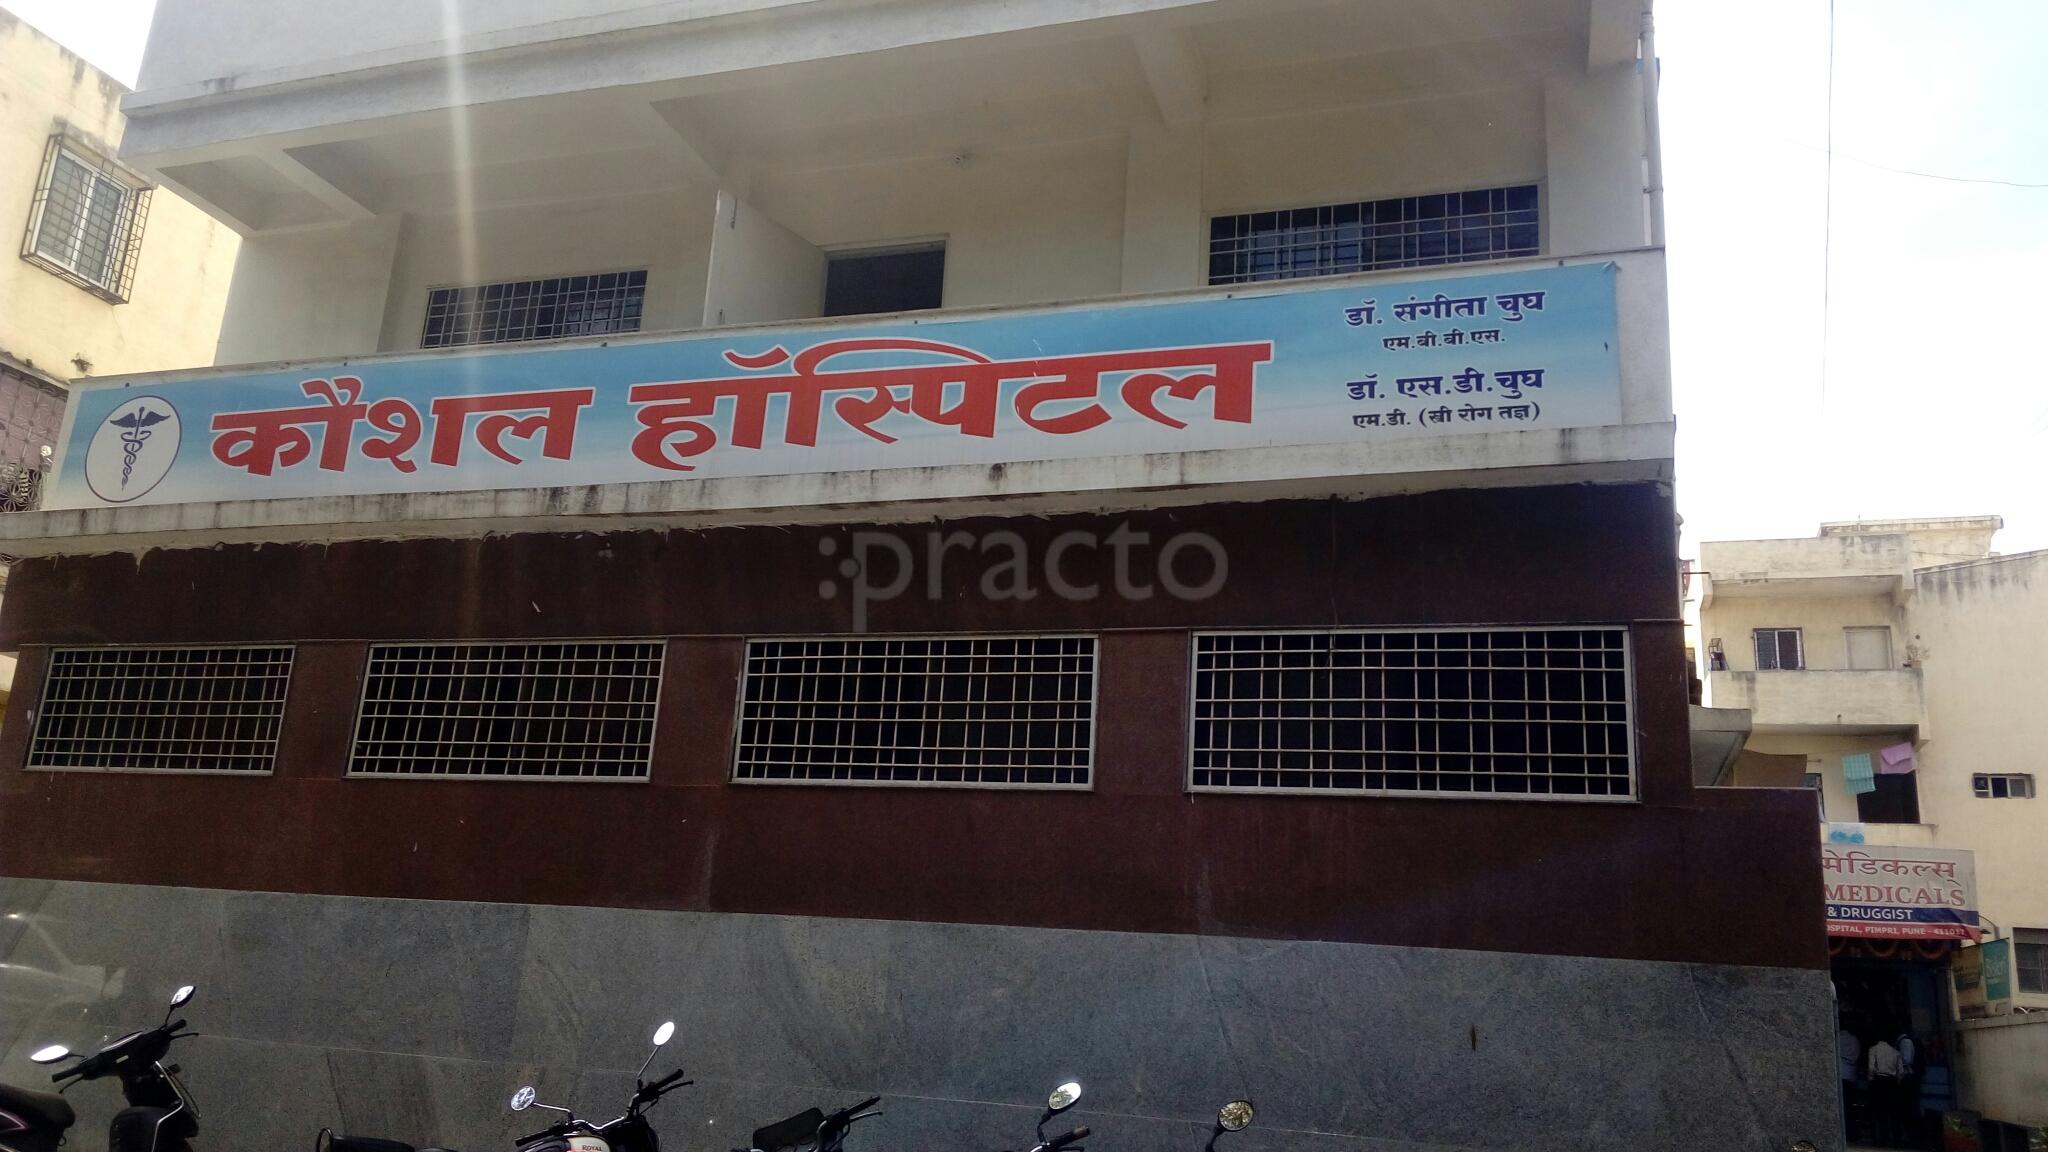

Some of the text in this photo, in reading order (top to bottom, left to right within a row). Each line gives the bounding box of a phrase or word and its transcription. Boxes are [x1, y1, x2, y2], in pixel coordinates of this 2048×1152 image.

[1345, 291, 1546, 326] डॉ. संगीता चुघ
[1347, 373, 1385, 400] डॉ.
[212, 338, 1272, 476] कौशल हॉस्पिटल
[1353, 408, 1411, 428] एम.डी.
[1457, 403, 1493, 422] रोग
[1825, 884, 1966, 906] MEDICALS
[1827, 906, 1914, 920] & DRUGGIST
[1902, 927, 1926, 935] PUNE
